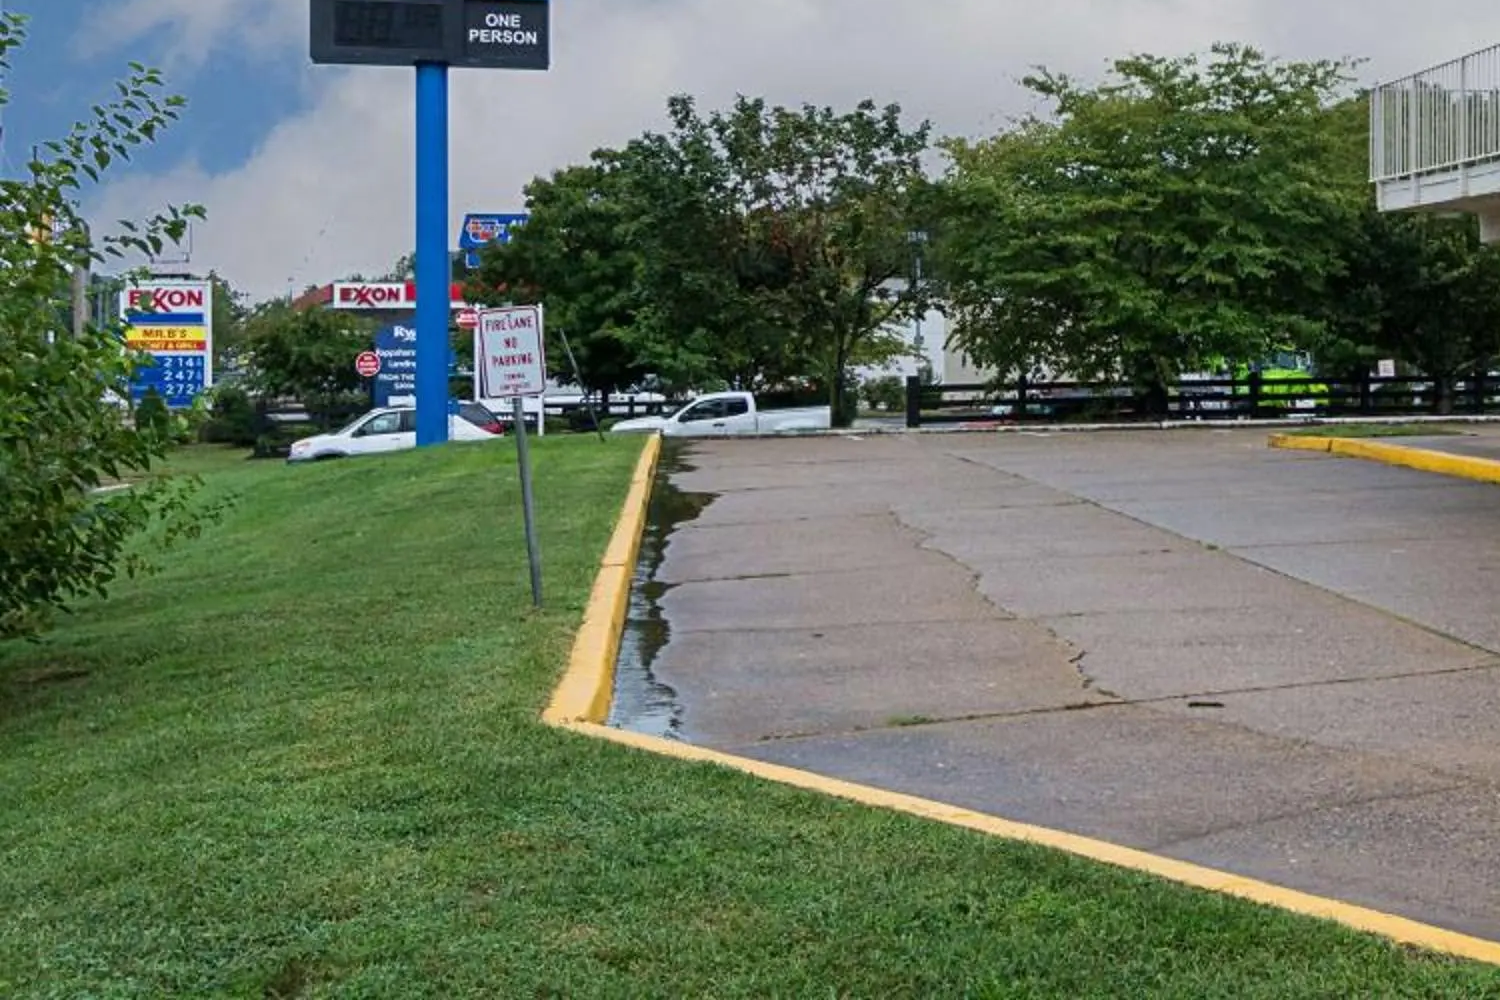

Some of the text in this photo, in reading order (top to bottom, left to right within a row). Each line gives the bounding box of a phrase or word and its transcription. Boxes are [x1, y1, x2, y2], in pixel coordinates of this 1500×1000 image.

[485, 13, 521, 29] ONE
[469, 29, 538, 45] PERSON
[127, 288, 204, 312] EXON
[340, 286, 400, 307] EXXON
[485, 316, 533, 332] FIRE LANE
[503, 336, 518, 349] NO
[491, 352, 533, 367] PARKING
